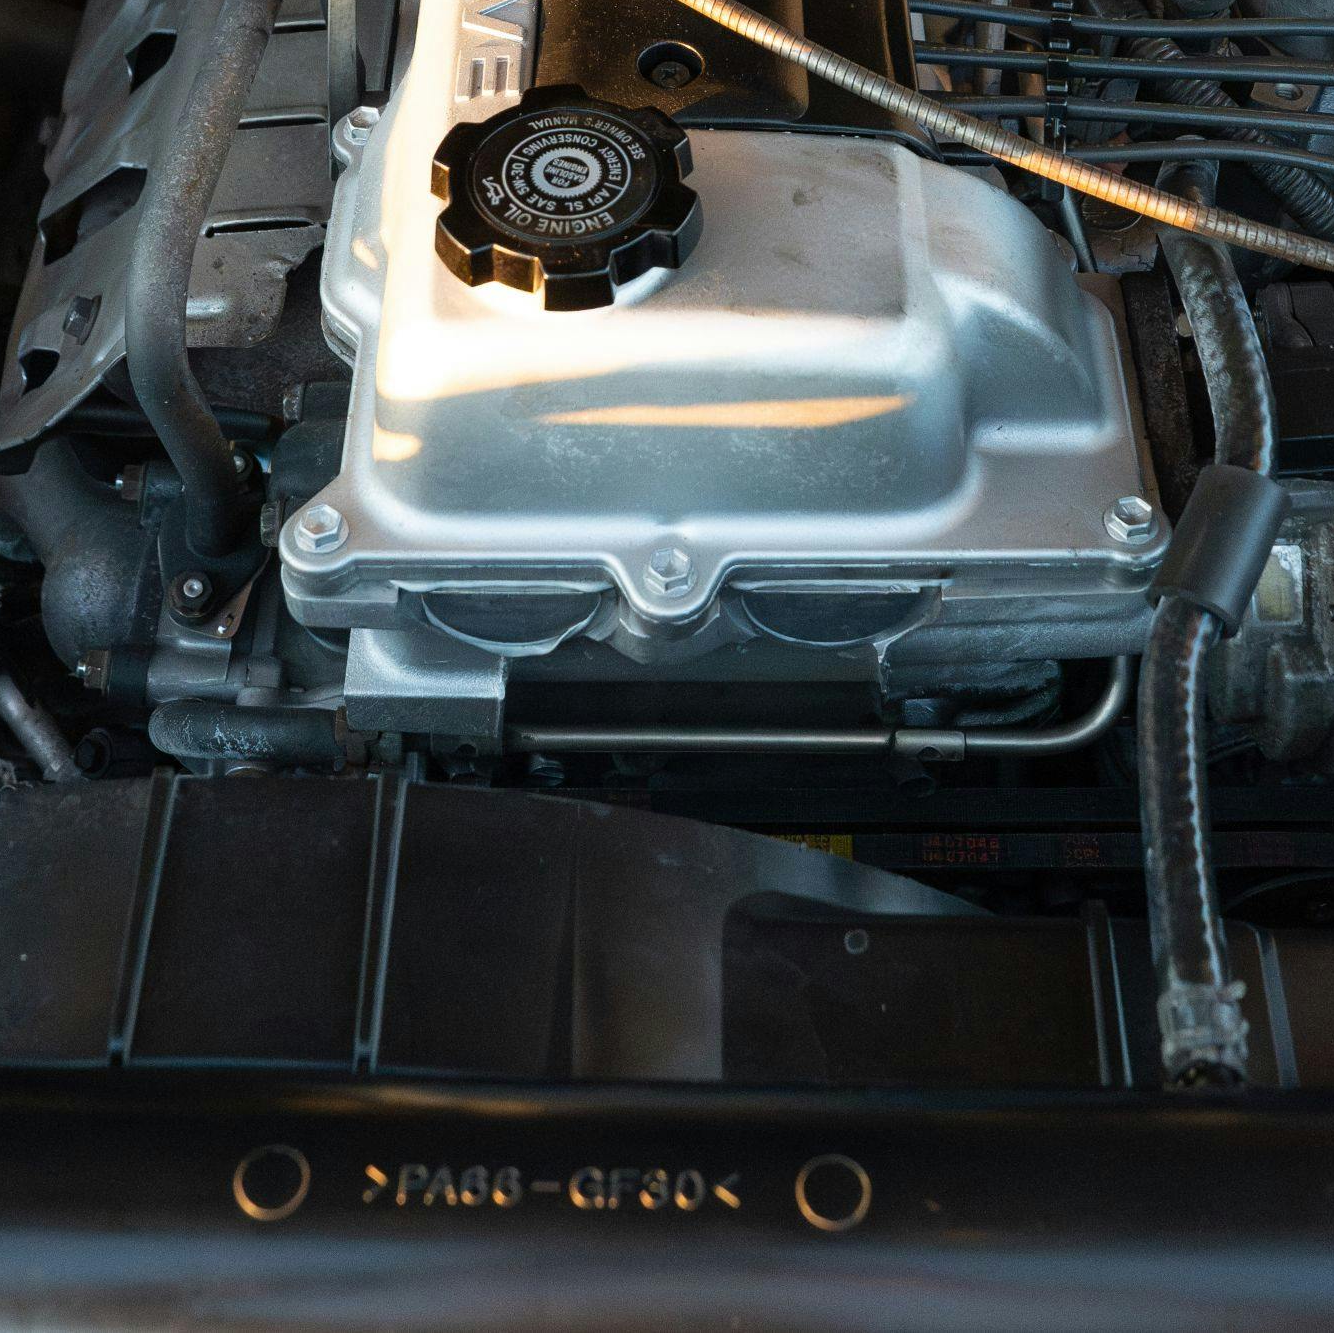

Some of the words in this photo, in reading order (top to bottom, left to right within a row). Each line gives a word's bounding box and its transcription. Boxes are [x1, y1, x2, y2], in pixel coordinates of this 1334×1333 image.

[528, 116, 578, 130] MANUAL
[584, 117, 633, 144] OWNER'S
[522, 133, 598, 156] CONSERVING
[627, 142, 646, 160] SEE
[552, 158, 588, 175] ENGINES
[598, 146, 622, 181] ENERGY
[511, 162, 530, 196] 5W-30
[551, 176, 571, 187] FOR
[527, 194, 556, 211] SAE
[565, 201, 584, 212] SL
[587, 188, 610, 207] API
[503, 203, 532, 226] OIL
[535, 211, 615, 235] ENGINE
